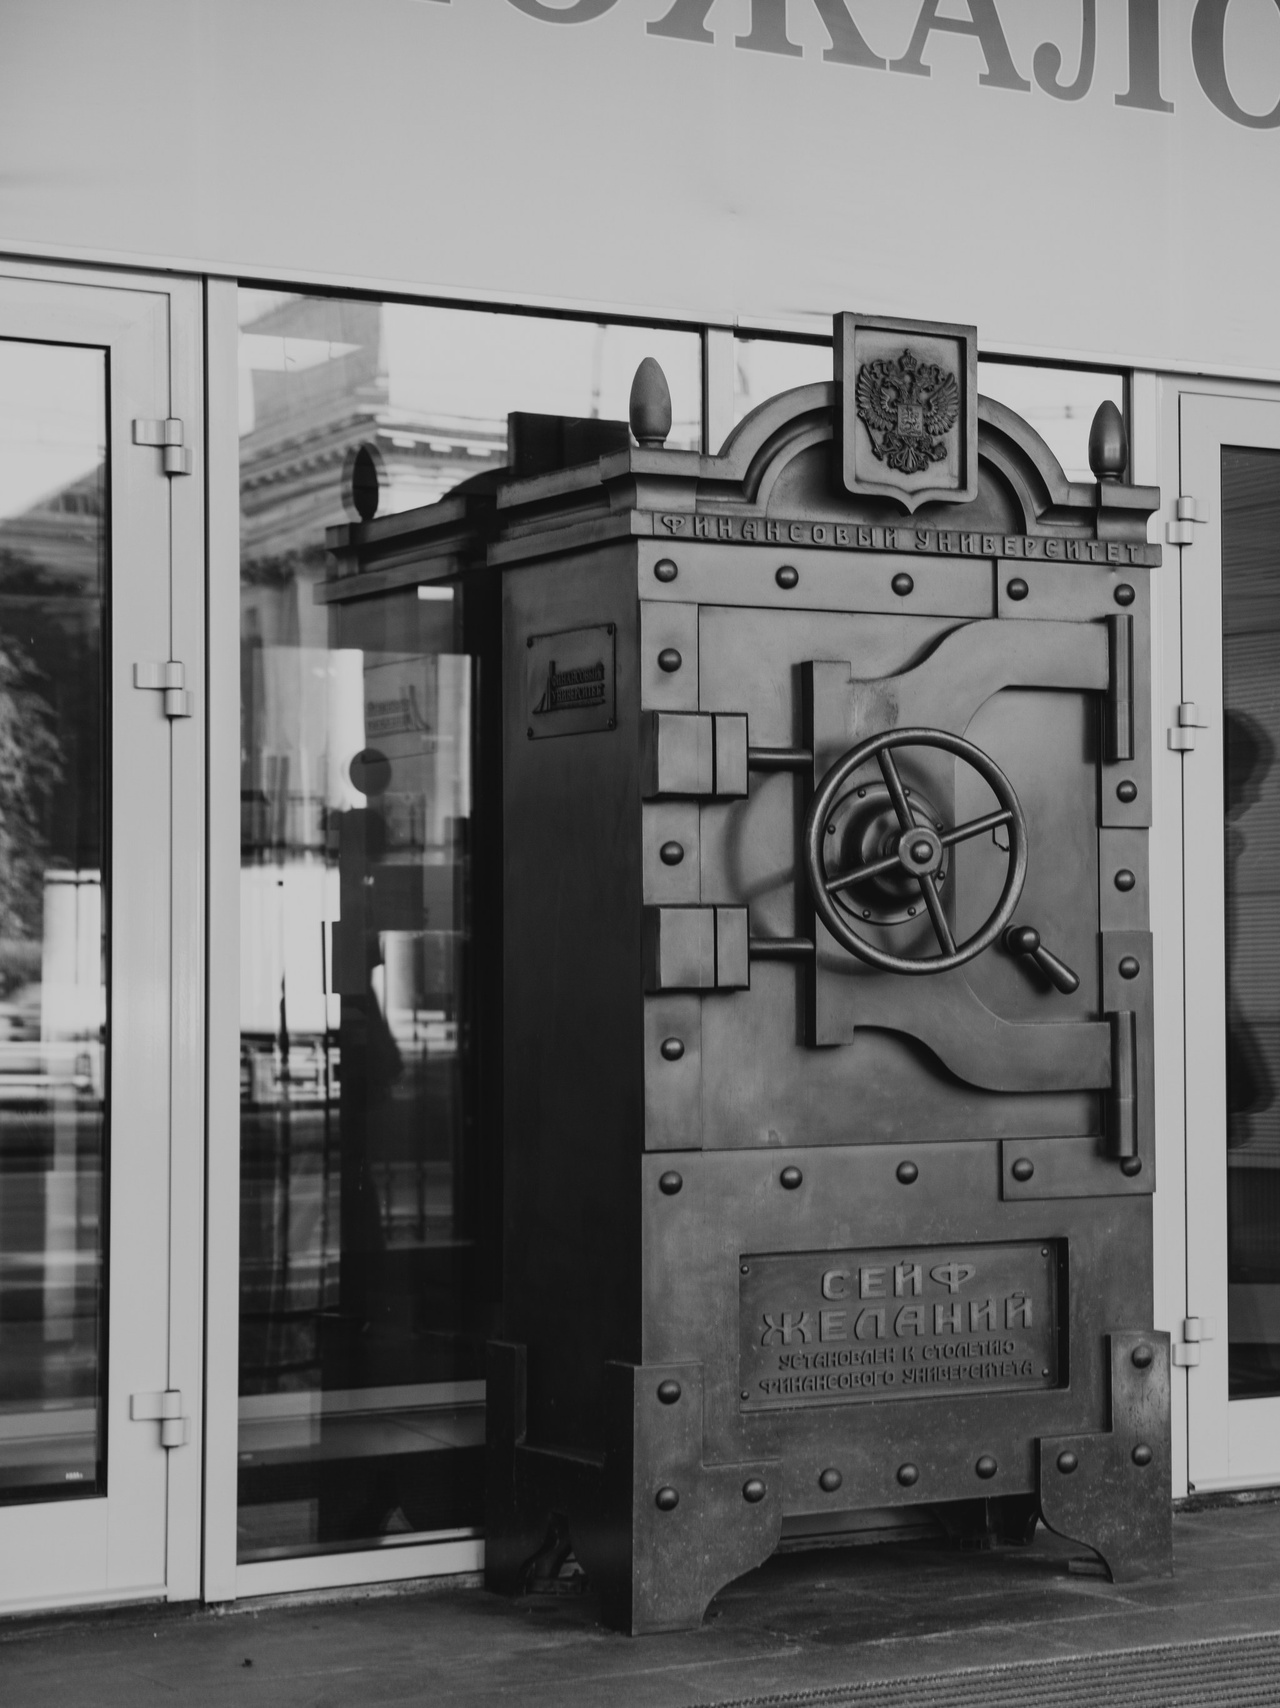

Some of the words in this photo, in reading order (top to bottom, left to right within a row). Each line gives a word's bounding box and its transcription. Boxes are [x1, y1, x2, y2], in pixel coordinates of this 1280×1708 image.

[661, 514, 900, 550] ФИНАНСОВЫЙ
[914, 529, 1142, 565] УНИВЕРСИТЕТ
[820, 1260, 977, 1301] СЕЙФ
[760, 1291, 1033, 1346] ЖЕЛАНИЙ
[778, 1347, 896, 1371] УСТАНОВЛЕН
[903, 1345, 916, 1362] К
[922, 1339, 1016, 1361] СТОЛЕТИЮ
[759, 1371, 896, 1395] ФИНАНСОВОГО
[902, 1359, 1034, 1384] УНИВЕРСИТЕТА
